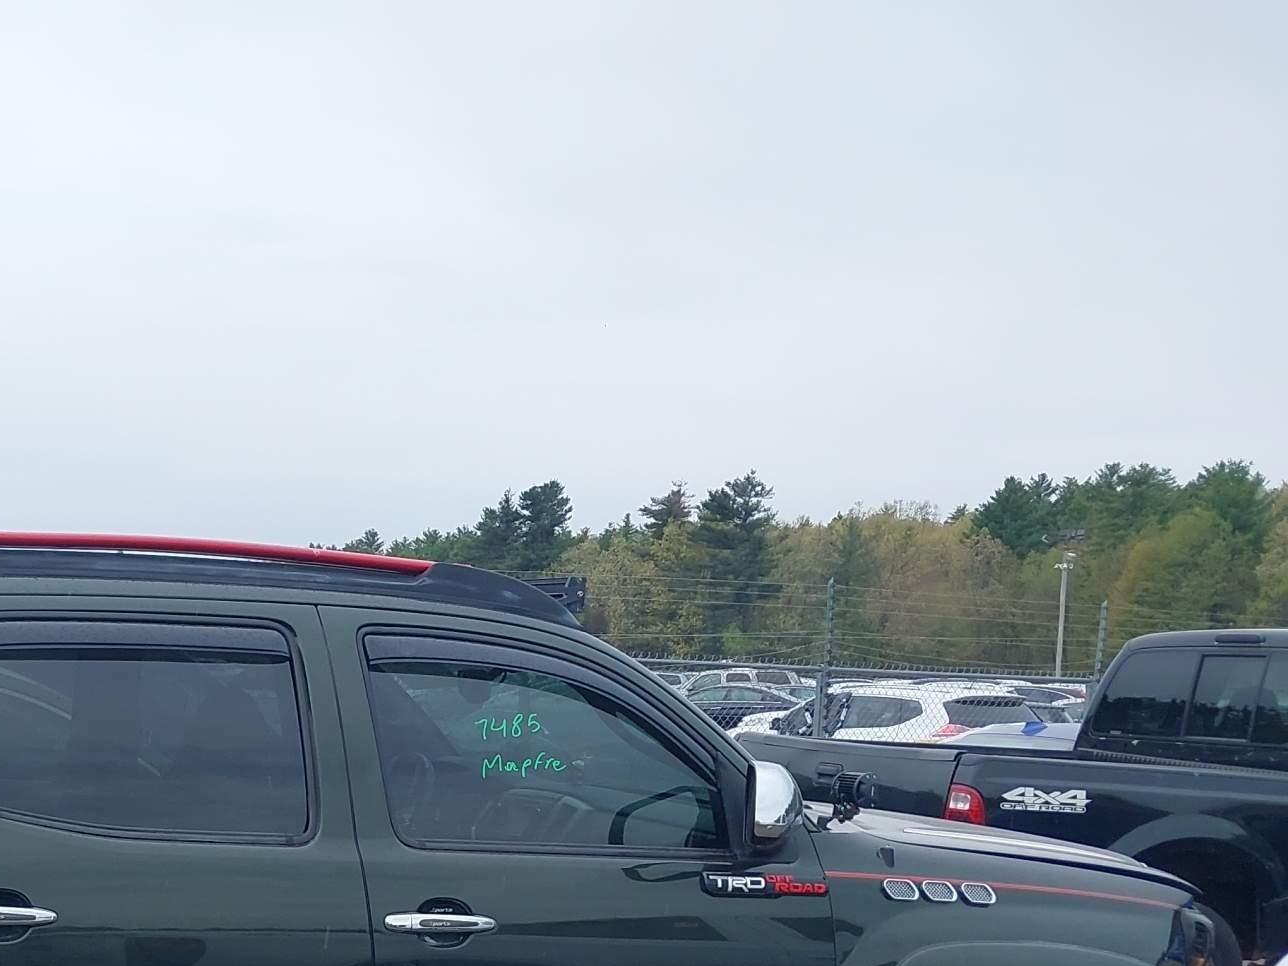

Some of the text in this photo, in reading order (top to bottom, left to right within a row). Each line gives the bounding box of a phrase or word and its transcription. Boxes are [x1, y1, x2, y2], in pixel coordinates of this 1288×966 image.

[482, 751, 567, 779] Mapfre
[709, 875, 765, 892] TRD
[765, 875, 793, 883] OFF
[775, 882, 826, 893] ROAD
